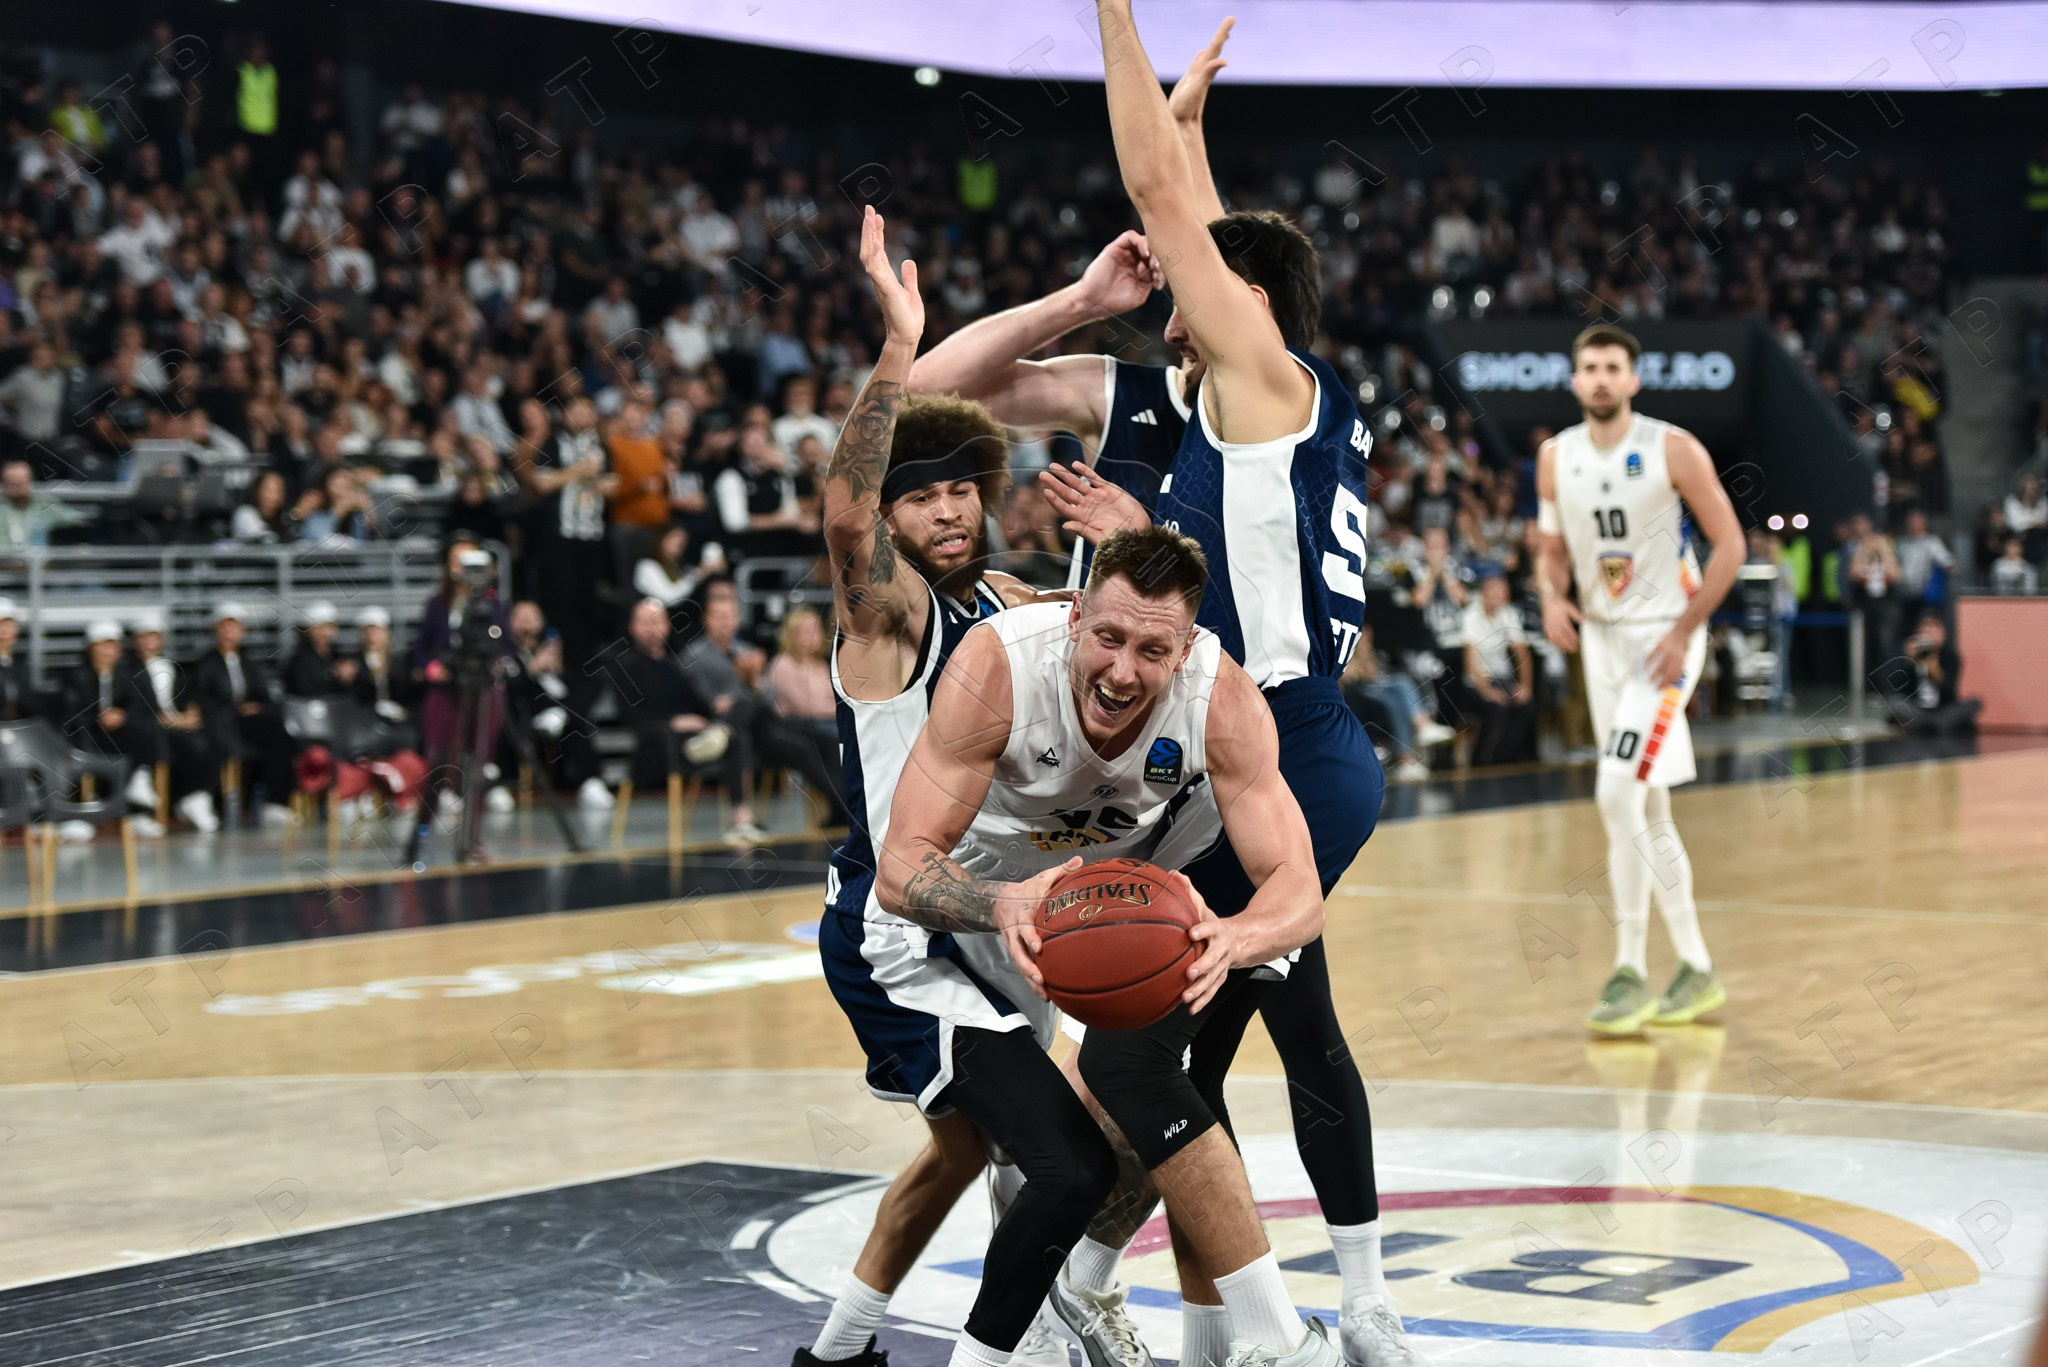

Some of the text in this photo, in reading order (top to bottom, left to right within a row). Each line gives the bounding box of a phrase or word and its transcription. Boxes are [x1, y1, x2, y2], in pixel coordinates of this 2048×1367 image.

[1458, 351, 1736, 391] SHOPT.RO
[1594, 508, 1627, 539] 10
[1145, 773, 1177, 783] EuroCup
[1044, 883, 1151, 923] SPALDING
